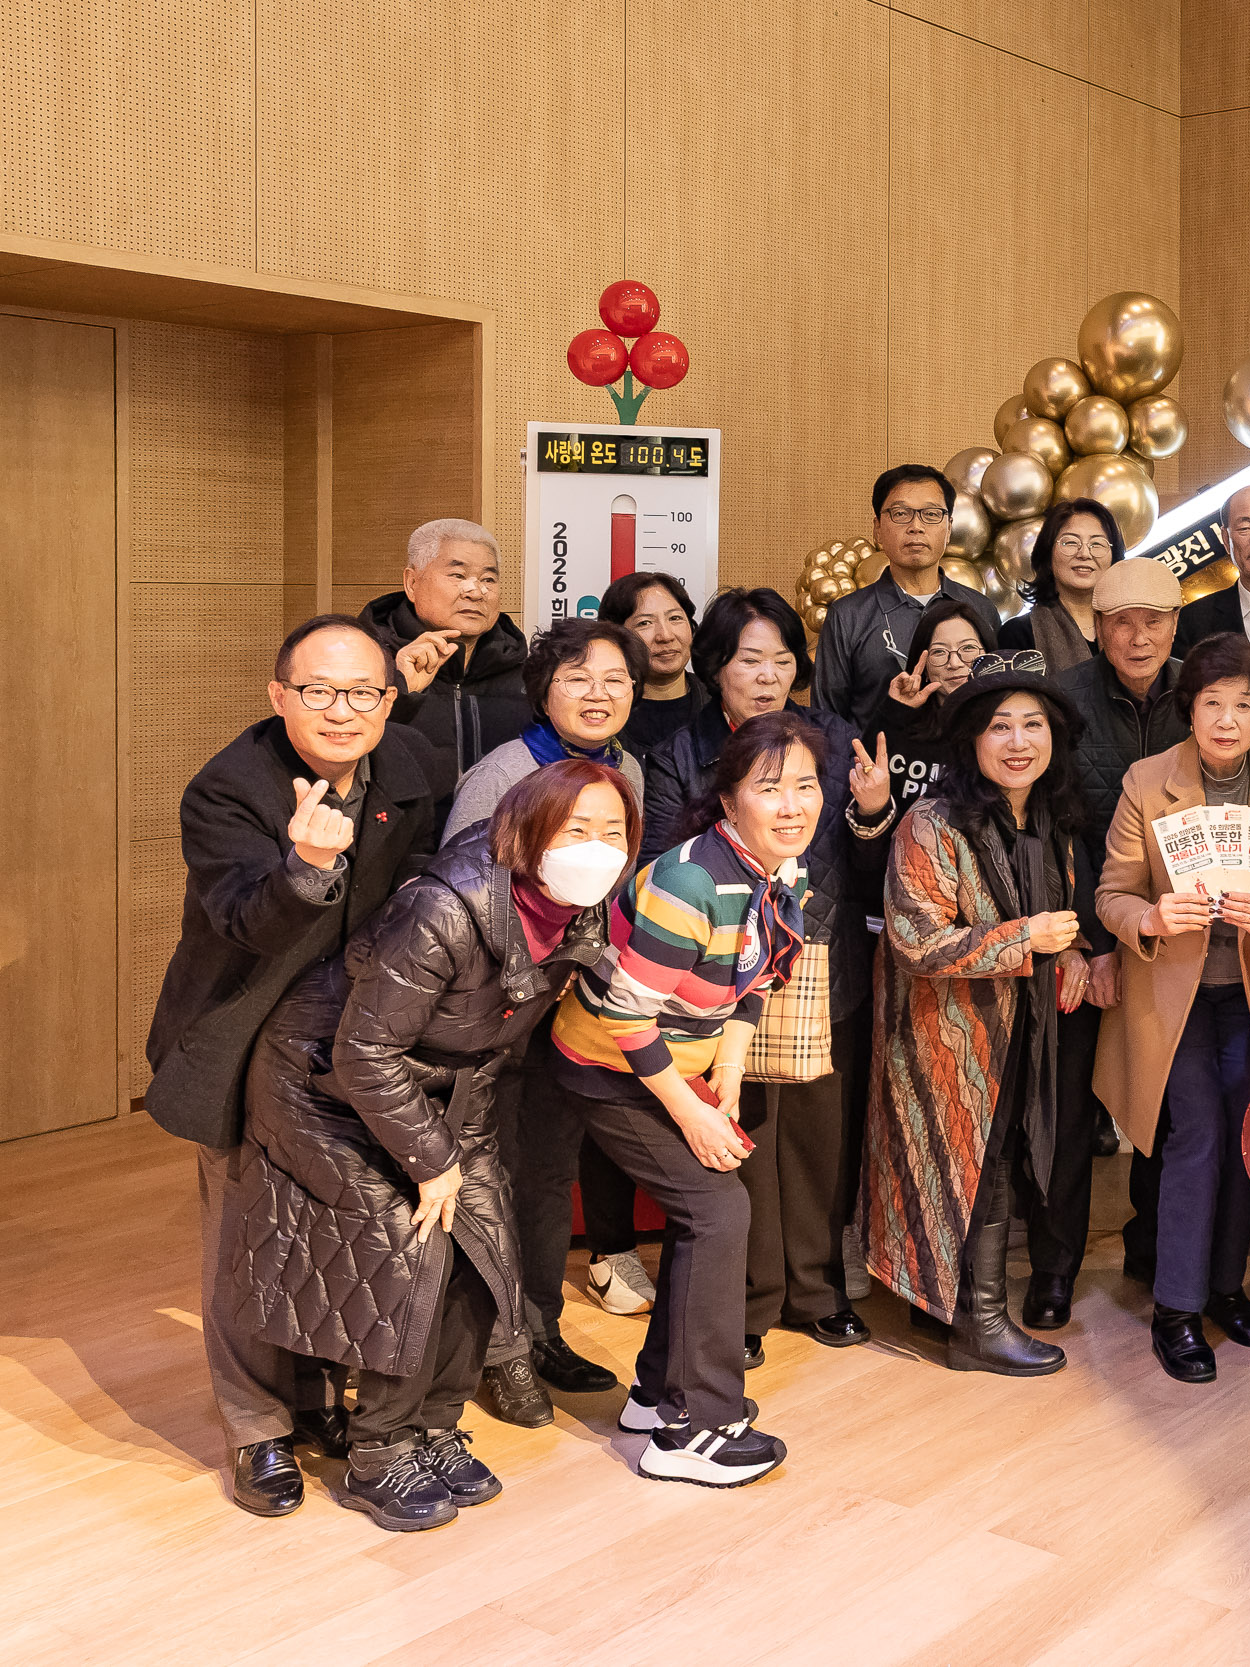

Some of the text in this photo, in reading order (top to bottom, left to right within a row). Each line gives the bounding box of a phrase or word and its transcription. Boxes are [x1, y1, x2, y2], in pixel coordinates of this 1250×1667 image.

[545, 439, 703, 467] 사랑의 온도 100.4 도
[670, 511, 693, 523] 100
[552, 522, 568, 594] 2026
[670, 543, 687, 554] 90
[1152, 530, 1215, 578] 광진
[1165, 831, 1206, 854] 따뜻한
[1211, 831, 1242, 844] 뜻한
[1169, 843, 1209, 863] 겨울나기
